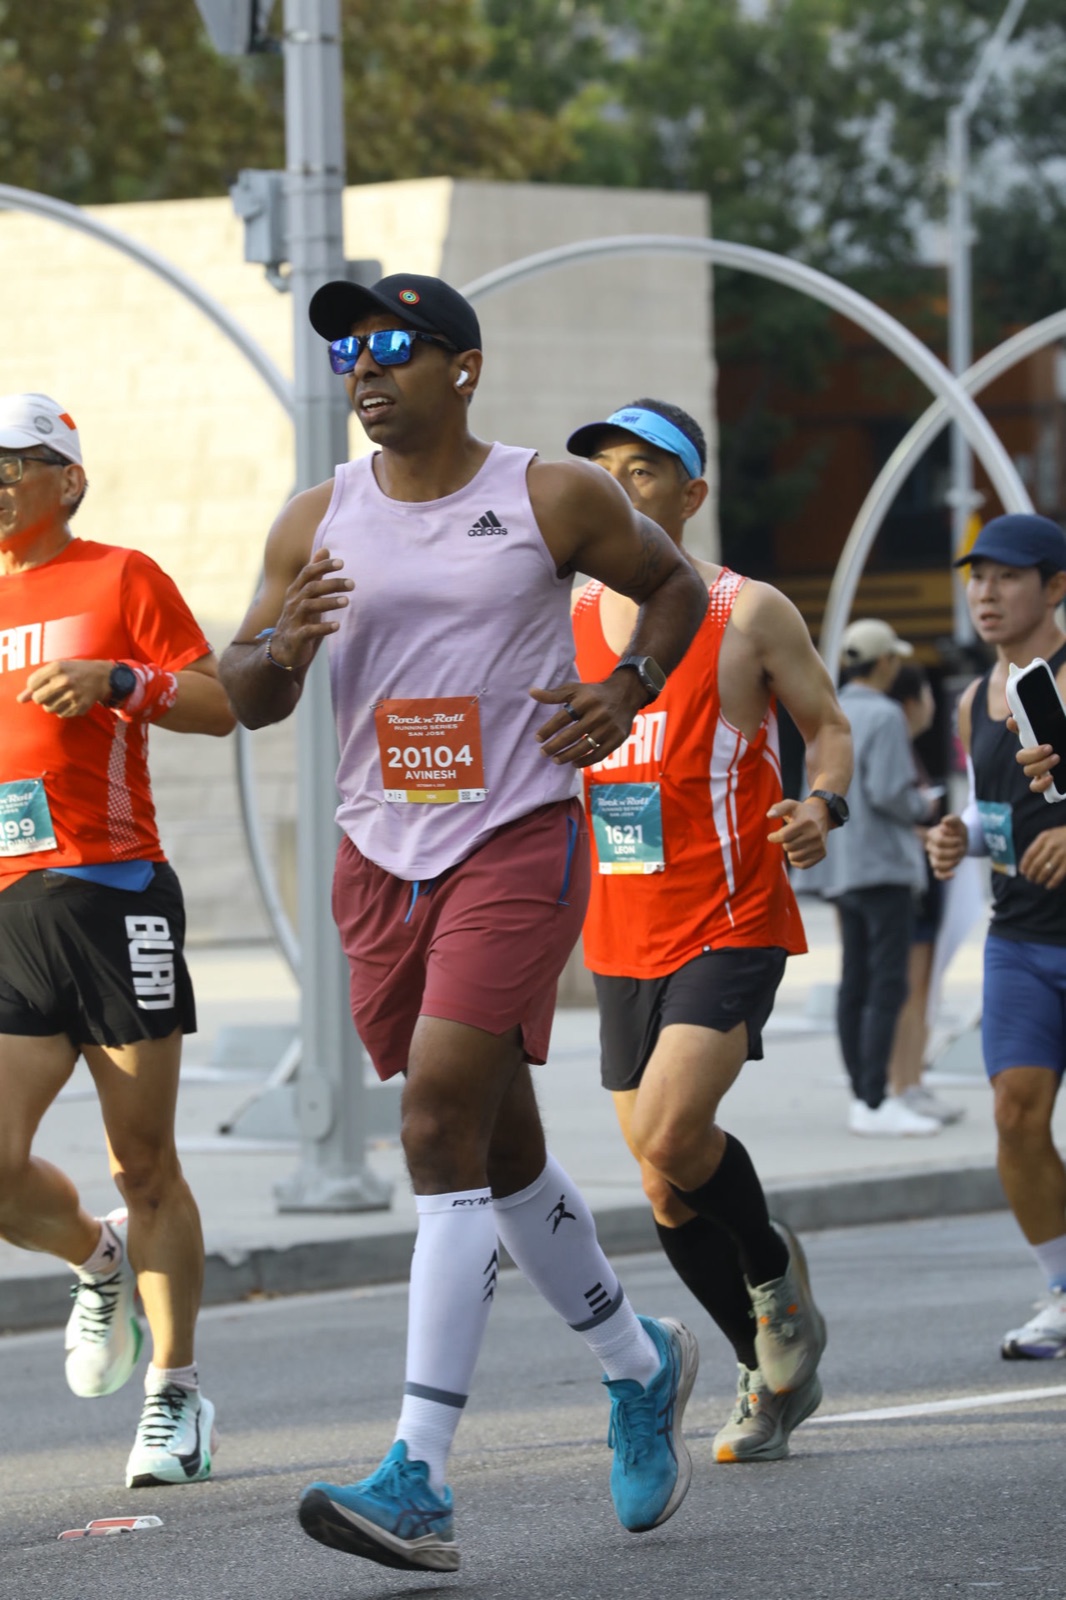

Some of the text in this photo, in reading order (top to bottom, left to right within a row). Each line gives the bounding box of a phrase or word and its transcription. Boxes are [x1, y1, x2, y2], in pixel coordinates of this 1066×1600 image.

[386, 714, 422, 724] Rock
[433, 713, 465, 722] Roll
[387, 745, 473, 769] 20104
[405, 770, 456, 780] AVINESH
[605, 825, 643, 844] 1621
[614, 846, 635, 854] LEON
[124, 915, 175, 1010] BURN
